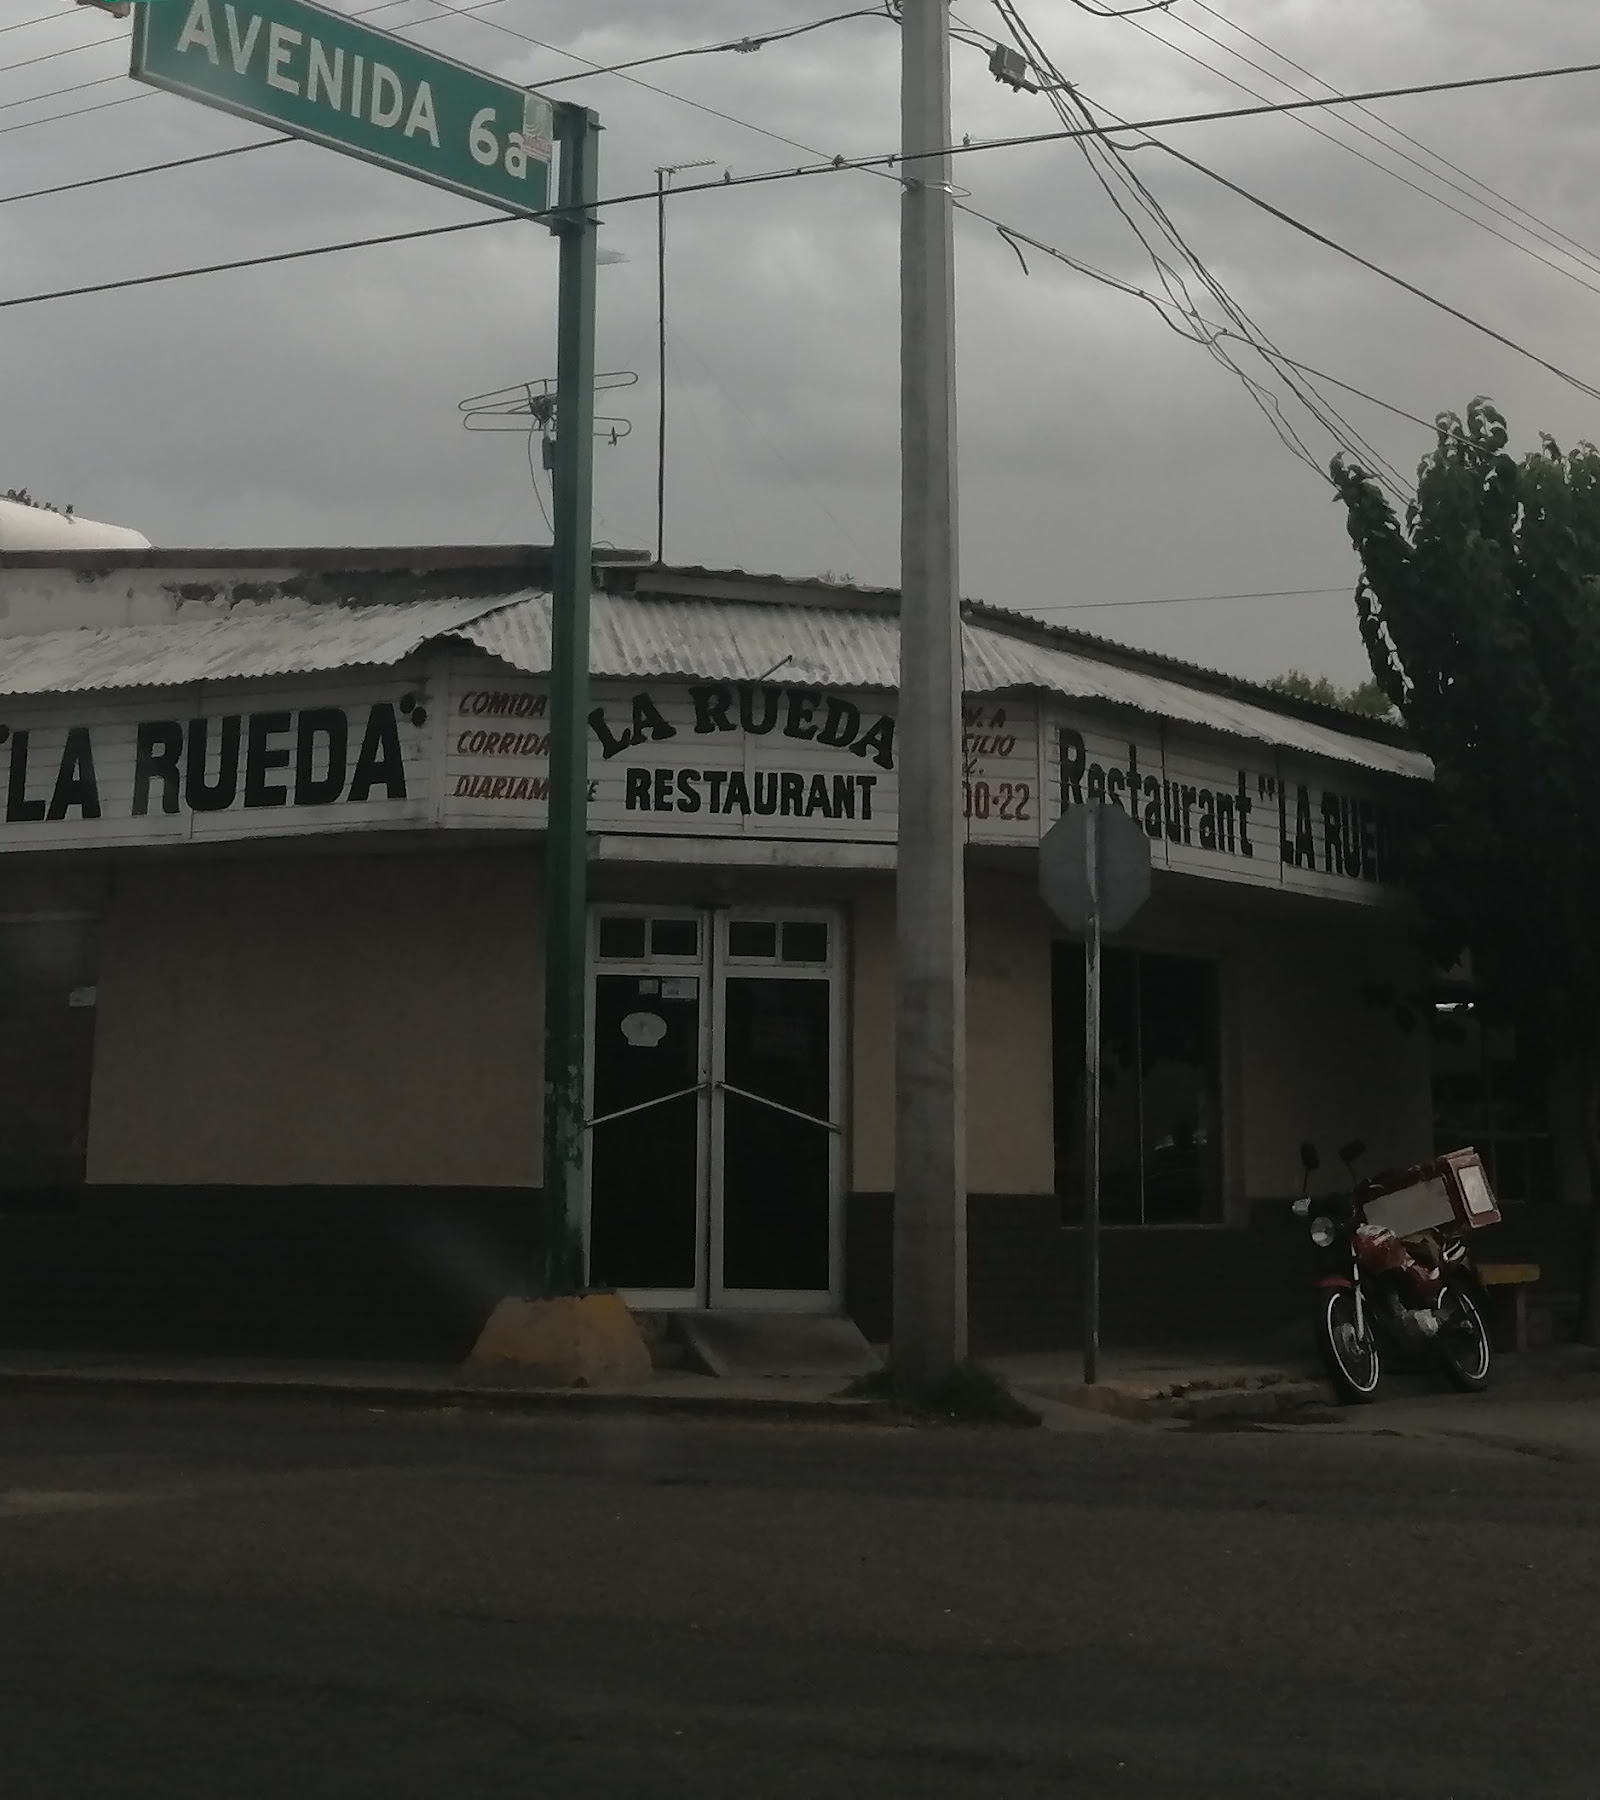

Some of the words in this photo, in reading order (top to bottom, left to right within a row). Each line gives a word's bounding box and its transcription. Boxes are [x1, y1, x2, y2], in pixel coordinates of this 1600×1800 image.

[468, 107, 527, 179] 6a
[457, 690, 548, 717] COMIDA
[587, 691, 677, 760] LA
[689, 684, 897, 770] RUEDA
[625, 766, 878, 821] RESTAURANT
